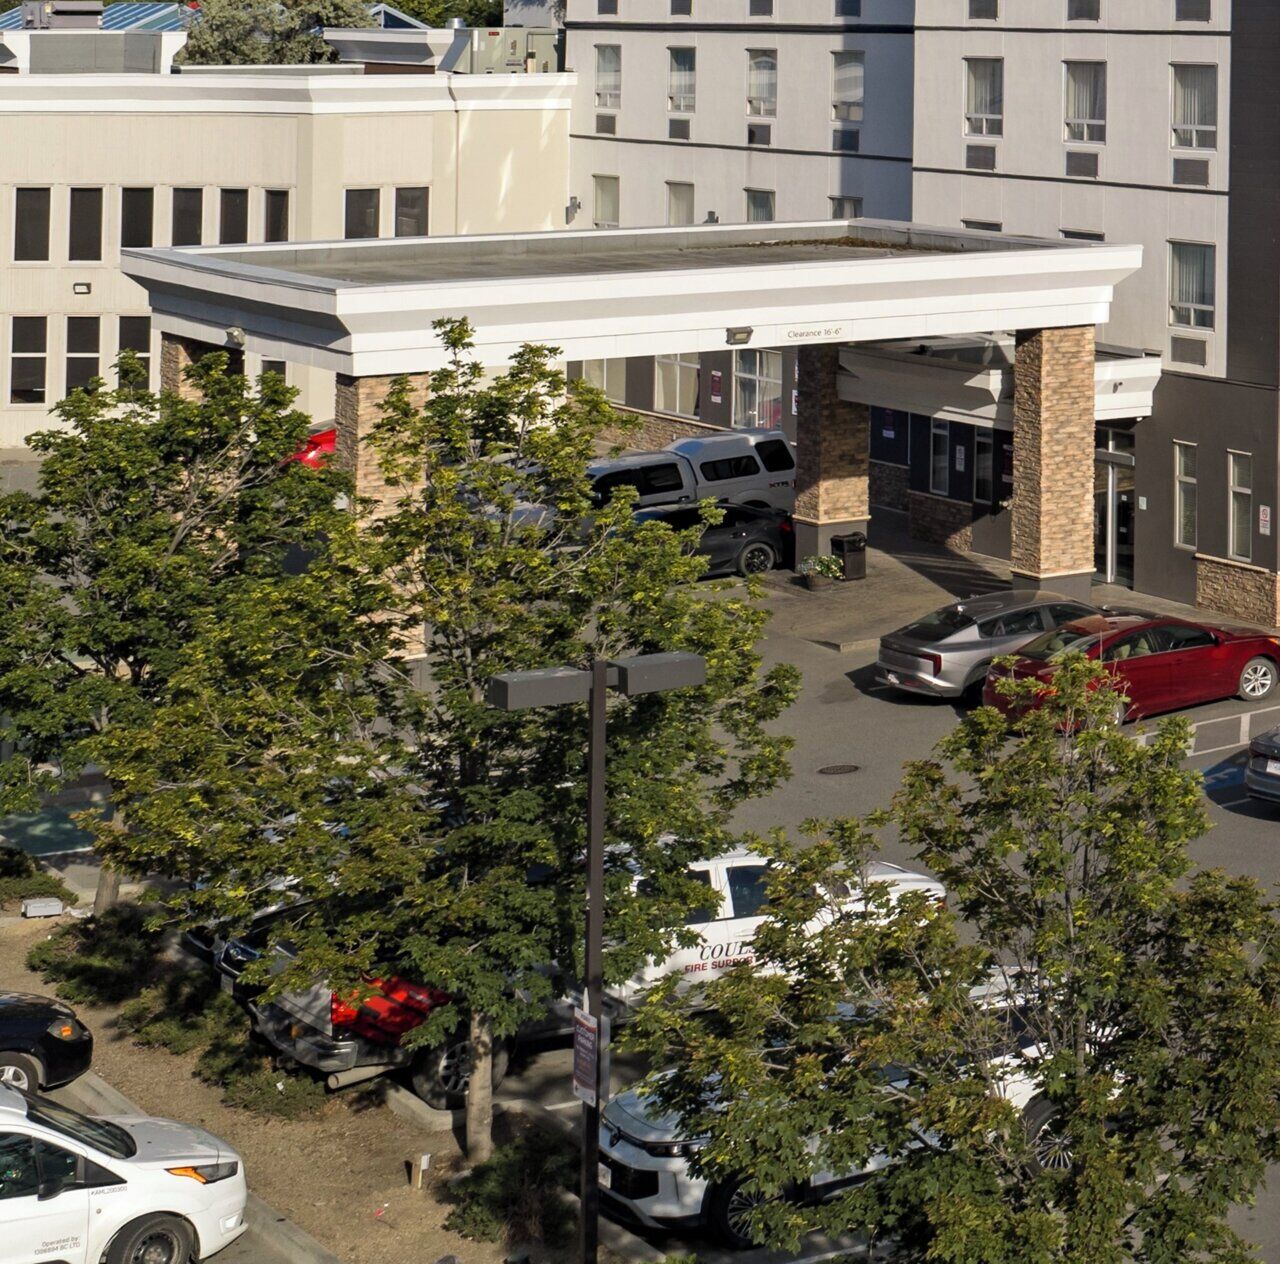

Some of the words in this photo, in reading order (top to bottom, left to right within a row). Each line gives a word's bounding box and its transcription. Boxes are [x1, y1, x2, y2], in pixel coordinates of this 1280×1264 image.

[787, 329, 822, 338] Clearance
[685, 962, 708, 973] FIRE
[711, 955, 754, 970] SUPPOR
